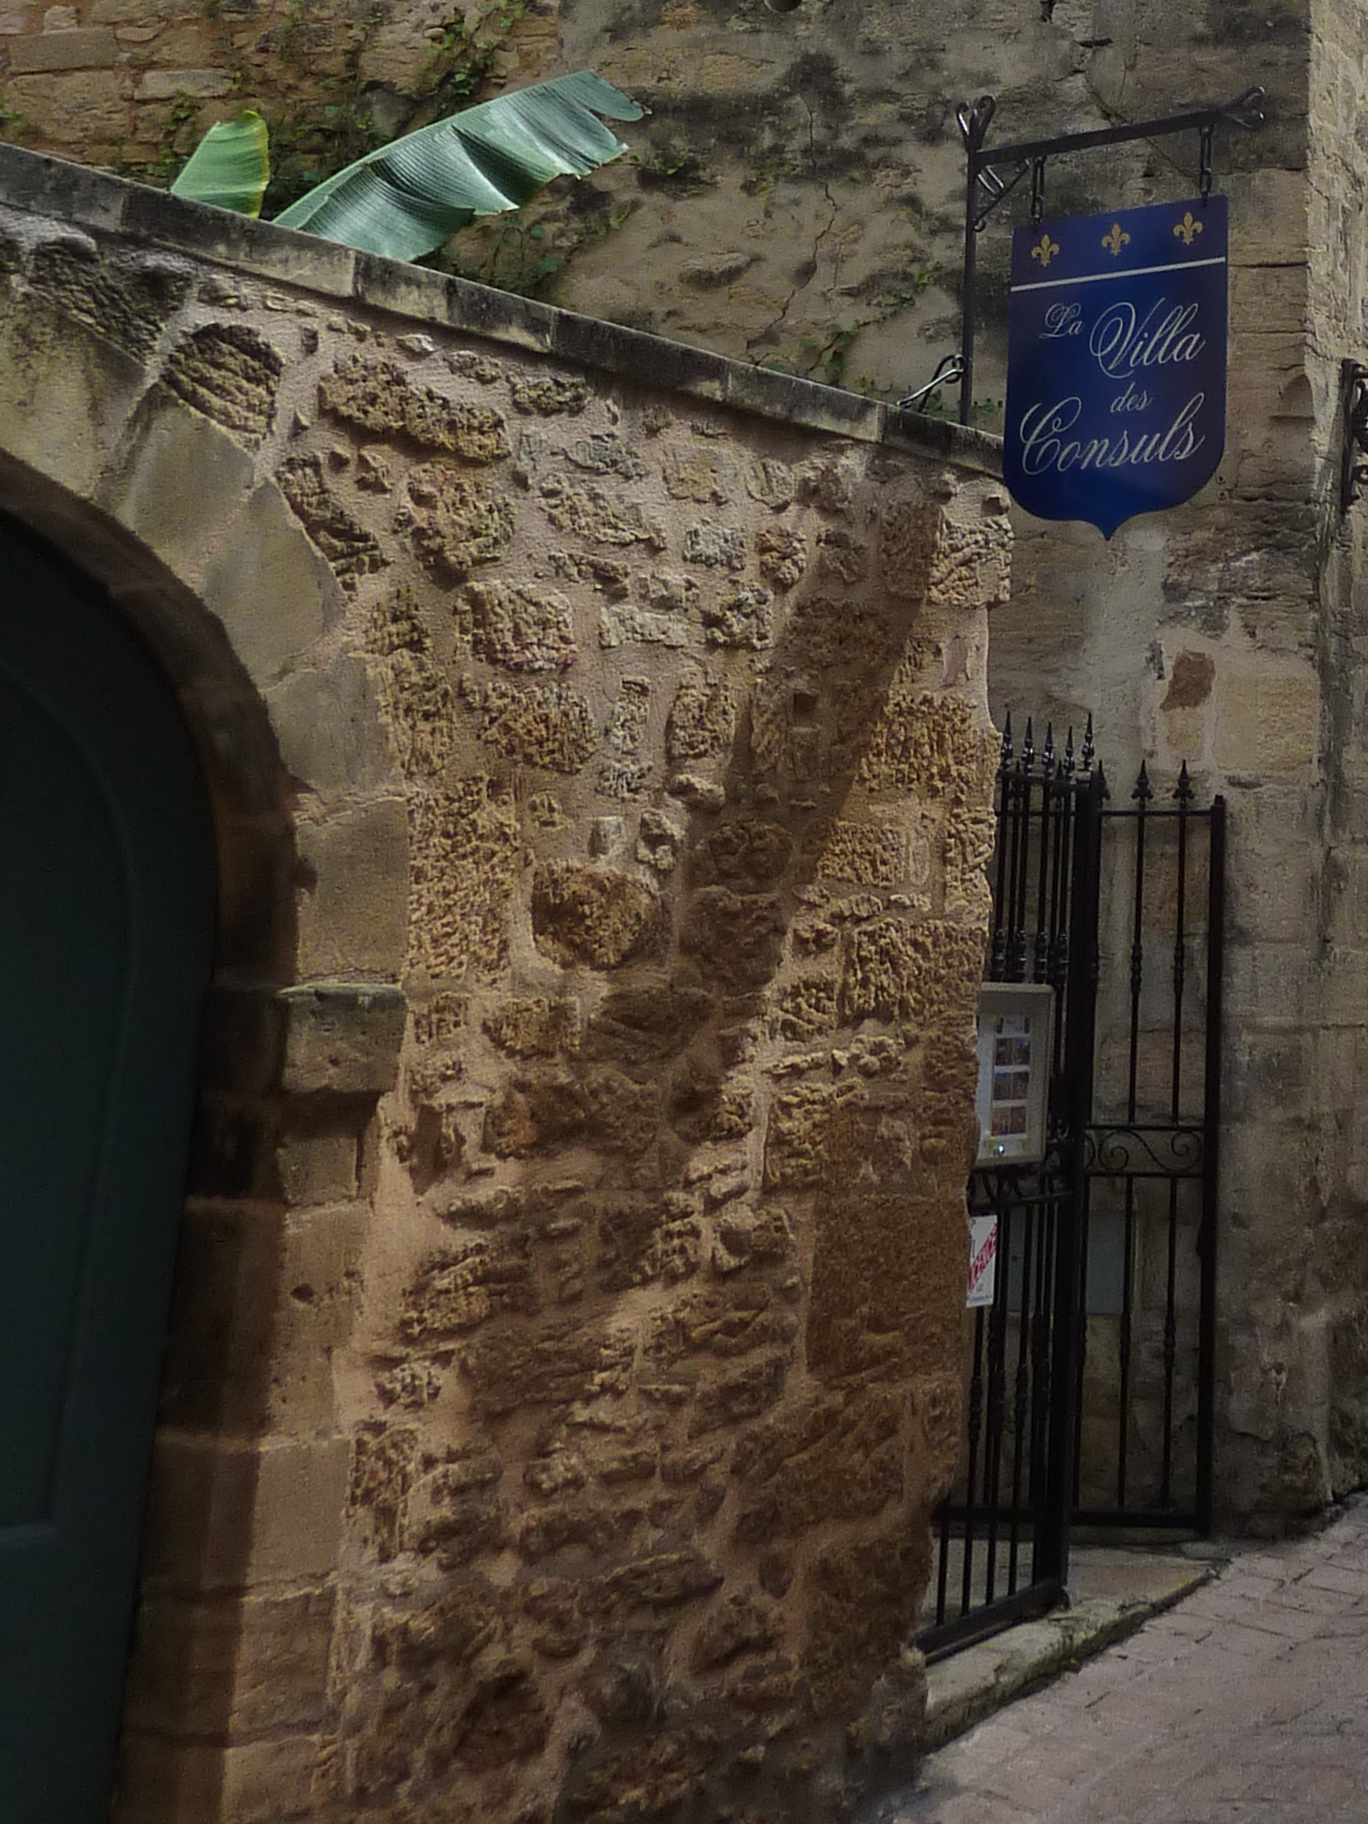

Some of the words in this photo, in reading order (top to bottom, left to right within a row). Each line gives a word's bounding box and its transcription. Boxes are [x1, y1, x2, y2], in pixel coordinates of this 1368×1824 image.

[1040, 303, 1083, 339] La
[1090, 297, 1206, 379] Villa
[1021, 392, 1206, 475] Consuls
[1110, 382, 1152, 413] des
